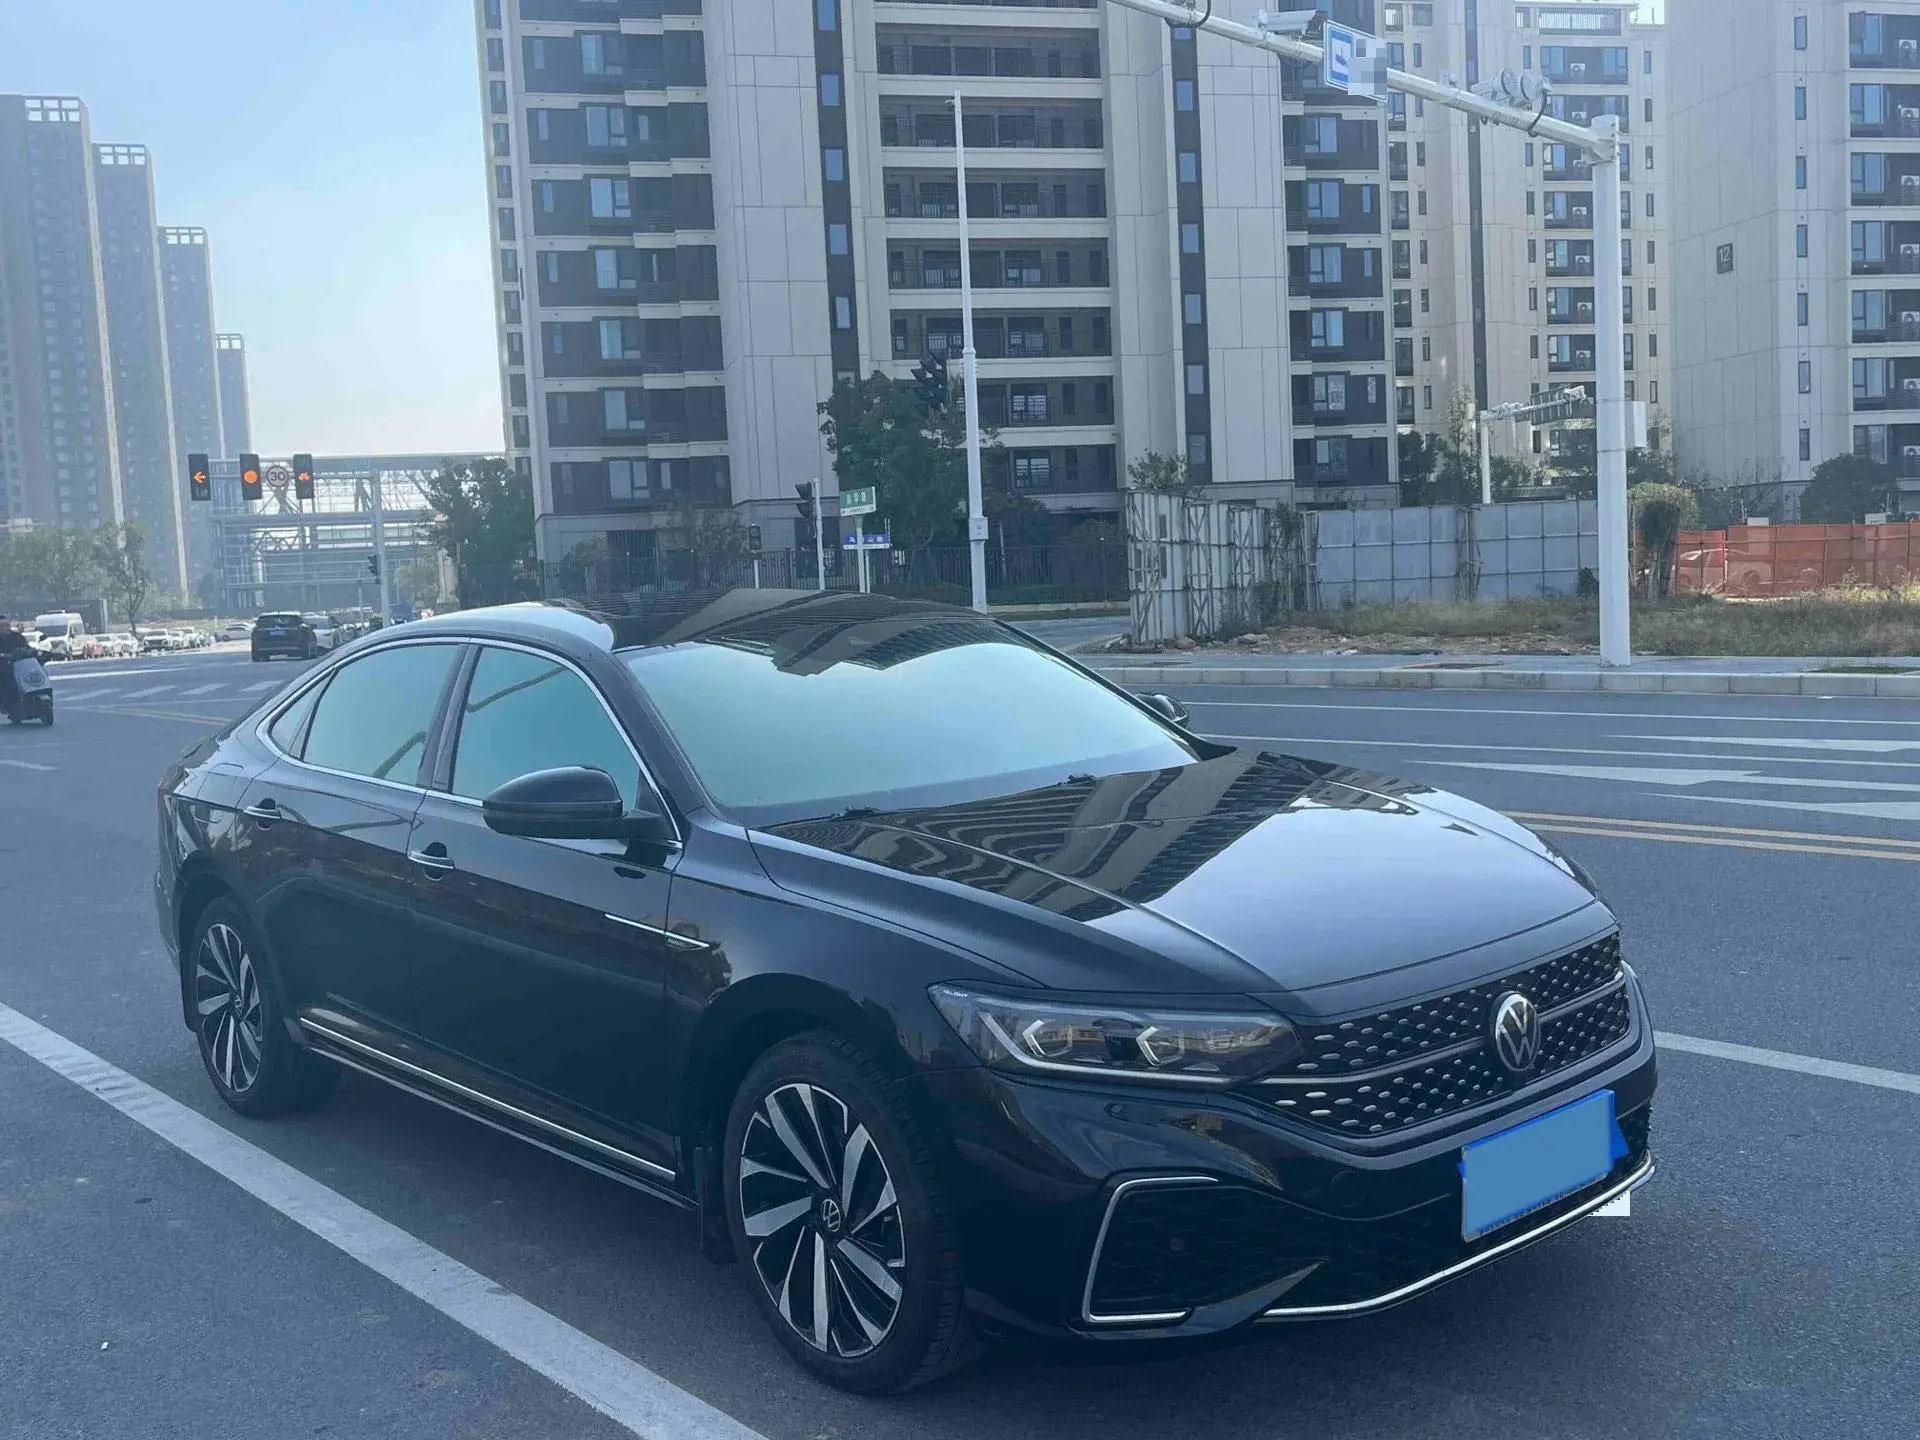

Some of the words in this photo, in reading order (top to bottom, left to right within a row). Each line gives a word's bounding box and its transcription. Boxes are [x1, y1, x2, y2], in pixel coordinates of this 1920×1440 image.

[1719, 247, 1731, 263] 12
[269, 472, 286, 481] 30
[1496, 993, 1539, 1071] VW
